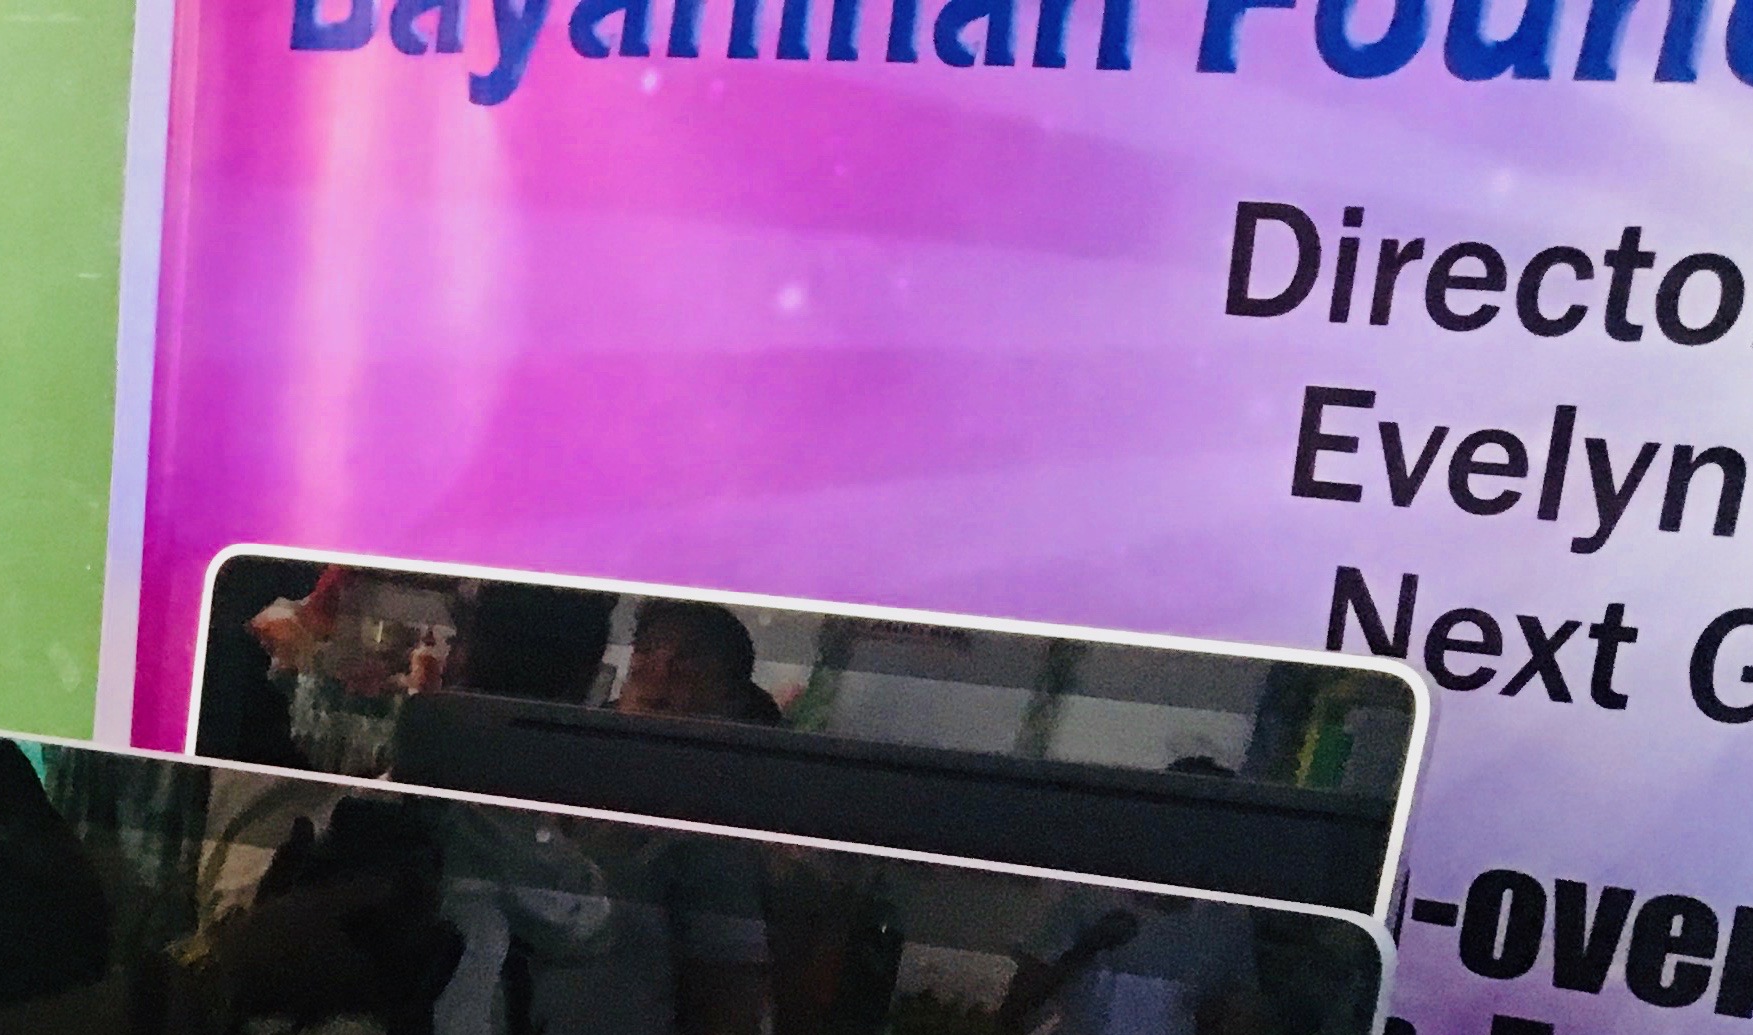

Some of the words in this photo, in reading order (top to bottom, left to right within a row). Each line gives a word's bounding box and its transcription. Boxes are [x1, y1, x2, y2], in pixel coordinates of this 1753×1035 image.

[1195, 0, 1753, 87] oun
[1225, 200, 1746, 346] Directo
[1291, 385, 1747, 554] Evelyn
[1326, 565, 1639, 710] Next
